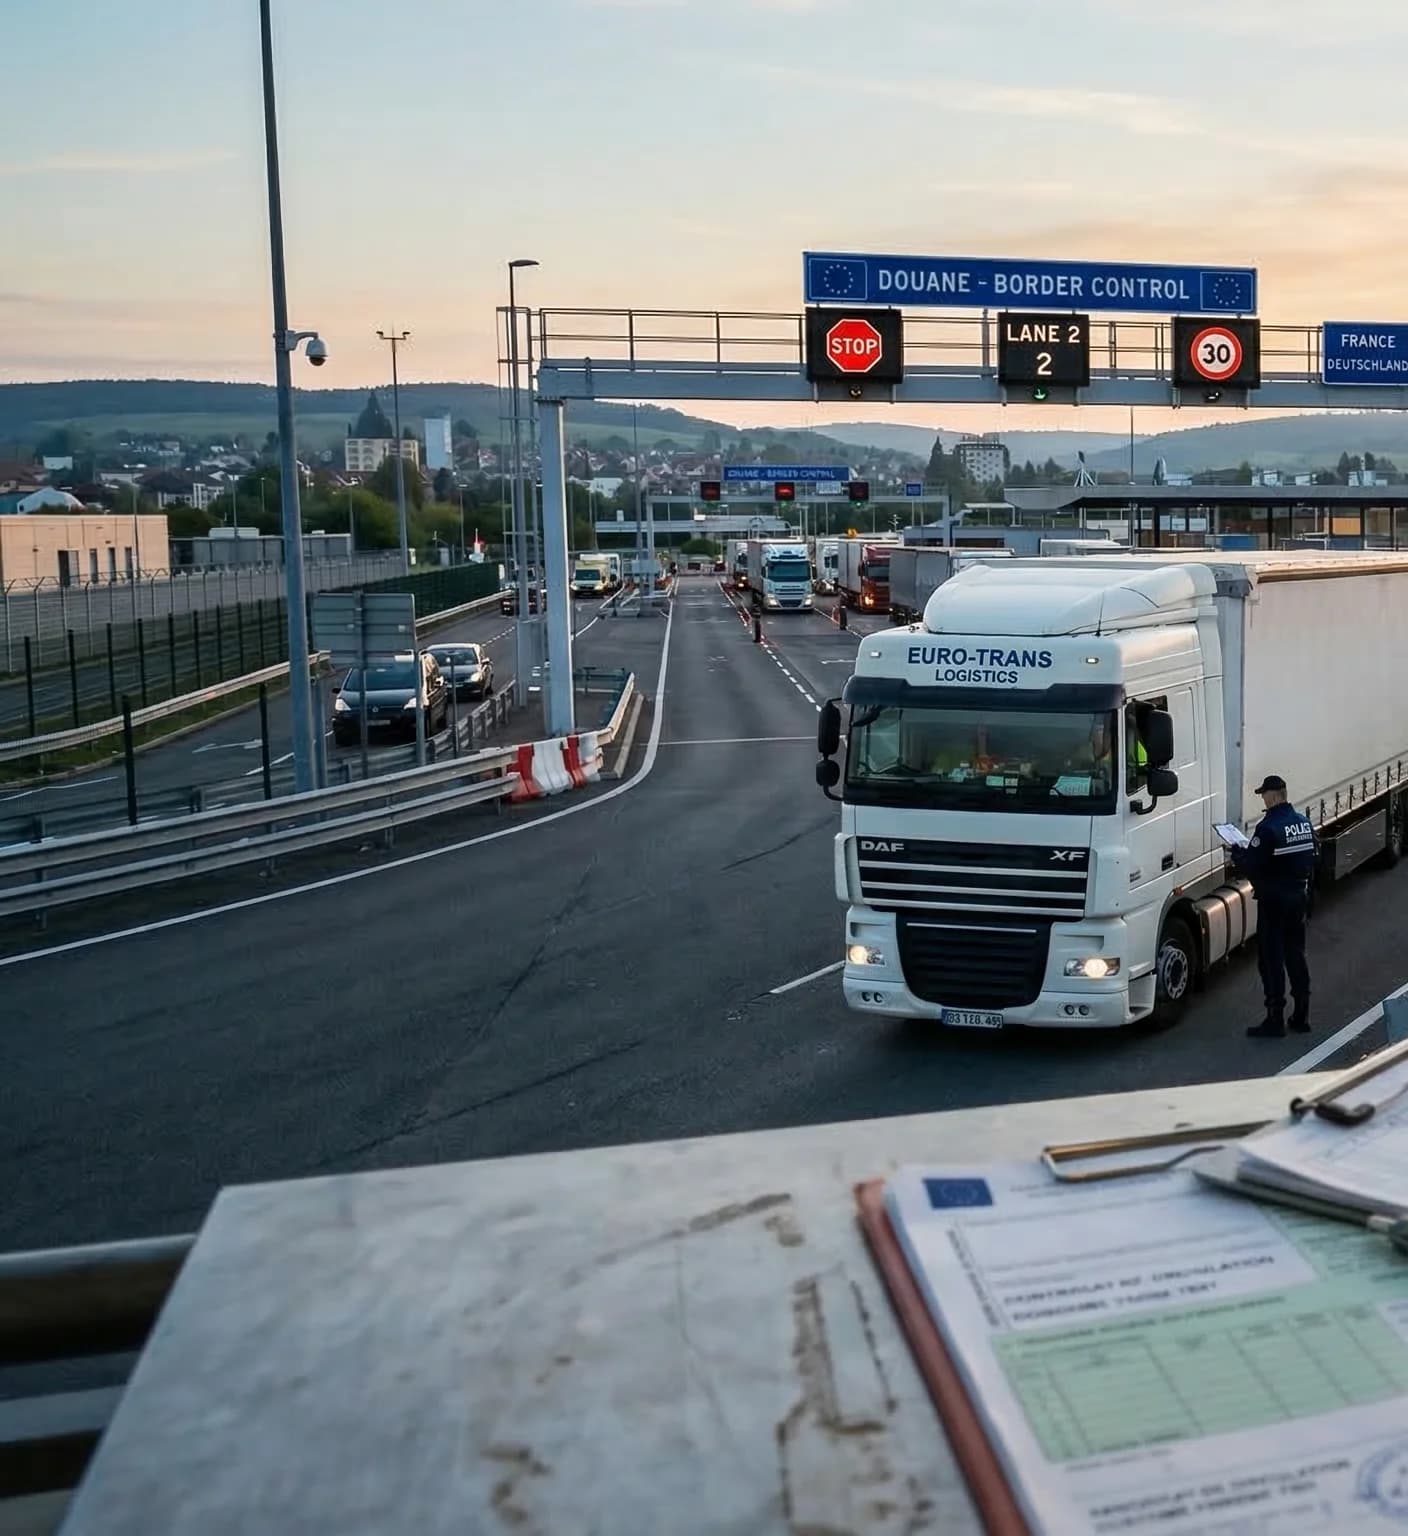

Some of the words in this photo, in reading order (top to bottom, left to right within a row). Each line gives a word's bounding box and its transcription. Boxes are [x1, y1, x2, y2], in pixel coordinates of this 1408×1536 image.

[878, 269, 971, 293] DOUANE
[994, 273, 1083, 297] BORDER
[1091, 277, 1190, 300] CONTROL
[1007, 323, 1060, 343] LANE
[1067, 325, 1080, 344] 2
[1341, 334, 1397, 349] FRANCE
[831, 337, 878, 355] STOP
[1202, 343, 1231, 365] 30
[1036, 352, 1053, 375] 2
[1327, 358, 1408, 372] DEUTSCHLAND
[908, 647, 1053, 669] EURO-TRANS
[935, 669, 1019, 684] LOGISTICS
[860, 840, 905, 852] DAF
[1050, 850, 1086, 861] XF
